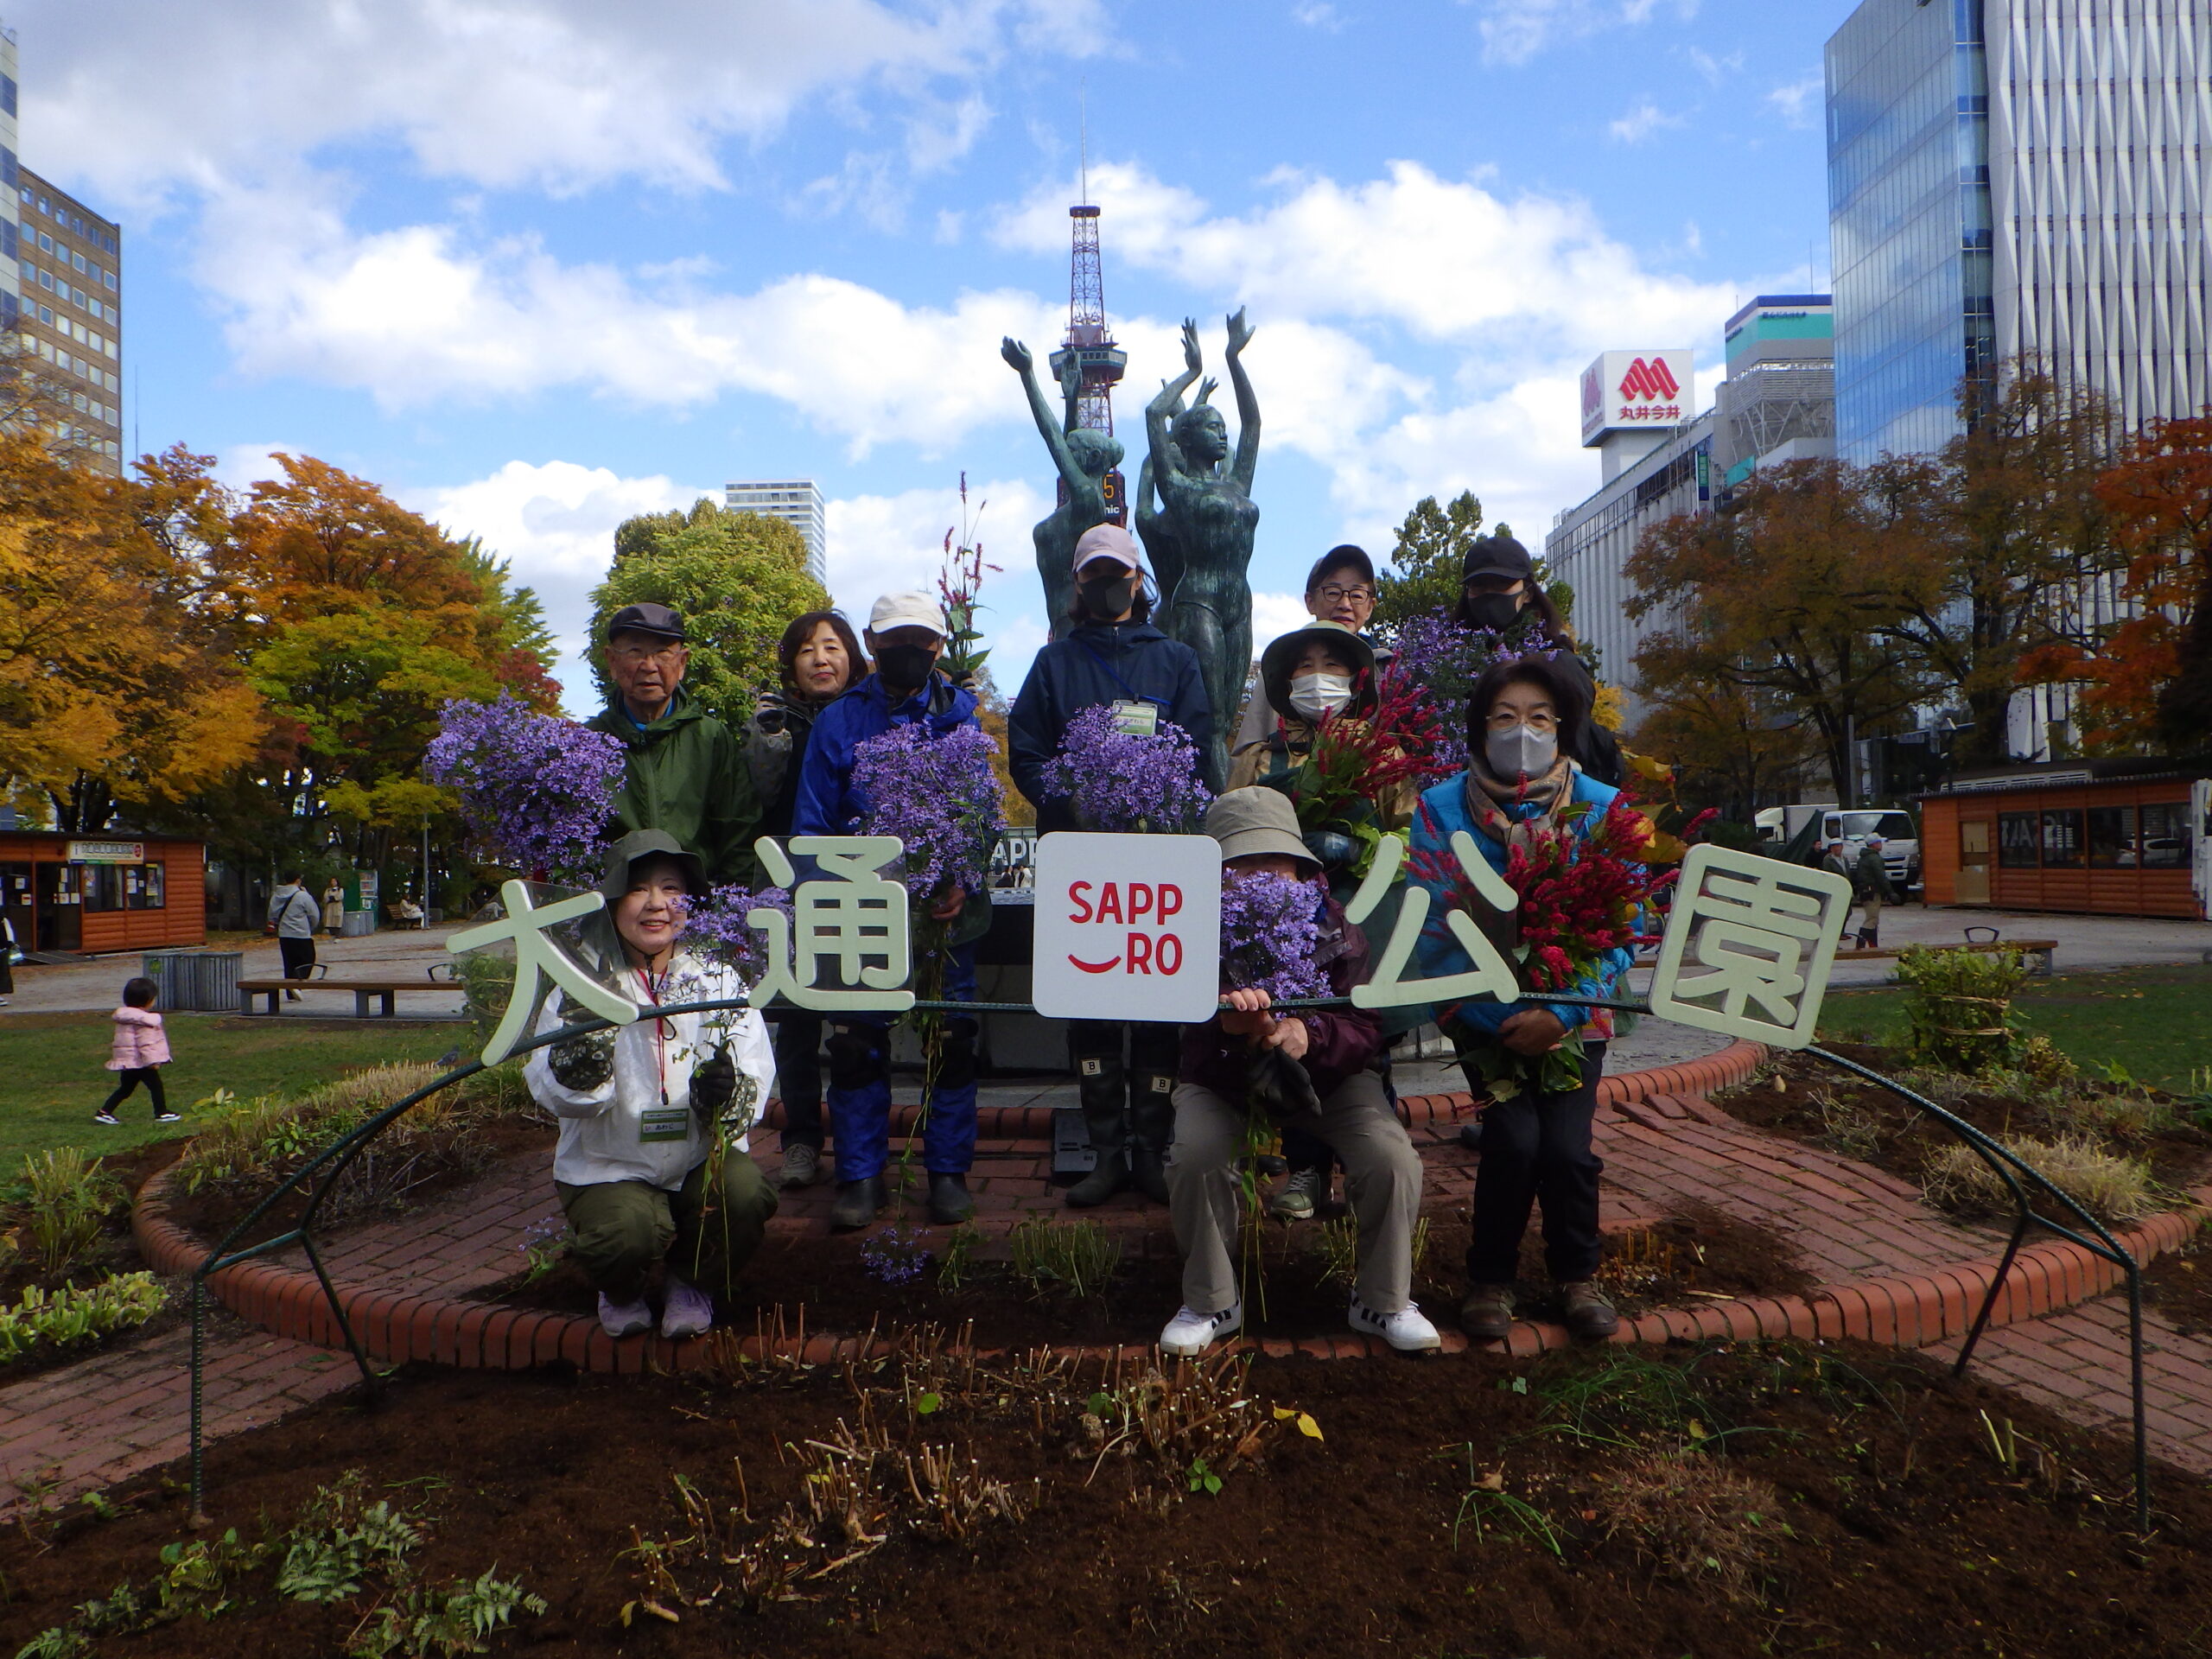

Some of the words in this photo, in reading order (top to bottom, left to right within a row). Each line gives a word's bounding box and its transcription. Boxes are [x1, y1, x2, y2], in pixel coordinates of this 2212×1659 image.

[1619, 404, 1681, 420] 丸井今井
[1068, 880, 1183, 925] SAPP
[1126, 931, 1183, 976] RO
